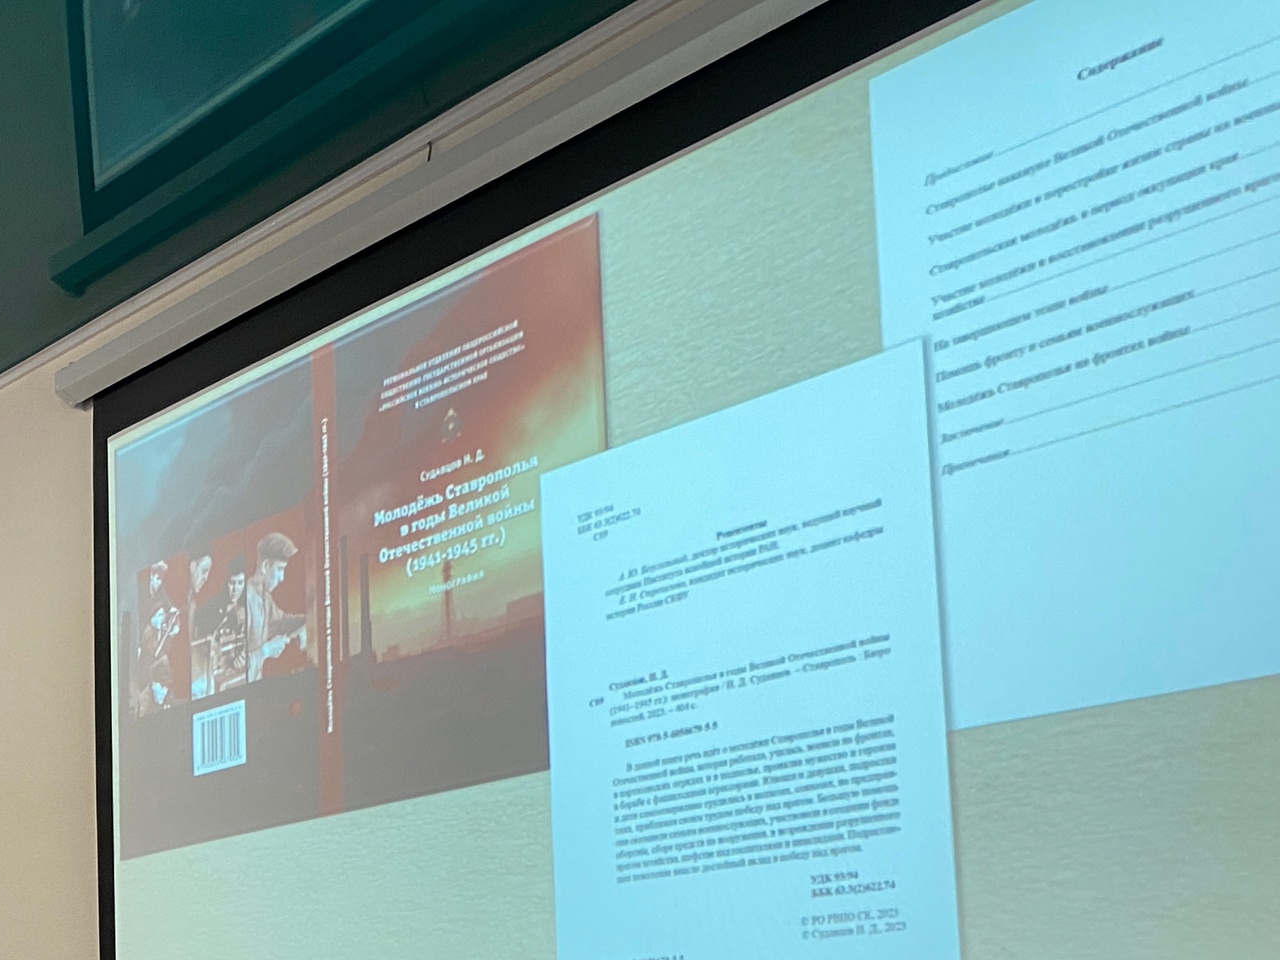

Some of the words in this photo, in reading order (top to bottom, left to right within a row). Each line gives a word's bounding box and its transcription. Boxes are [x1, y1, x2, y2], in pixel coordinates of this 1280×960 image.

[1076, 37, 1164, 80] Содержание
[1053, 134, 1105, 164] Великой
[1106, 94, 1203, 141] Отечественной
[373, 493, 443, 527] Молодёжь
[445, 450, 539, 499] Ставрополья
[400, 524, 409, 536] в
[411, 509, 446, 533] годы
[448, 483, 510, 519] Великой
[378, 513, 484, 563] Отечественной
[486, 497, 534, 525] войны
[405, 536, 478, 577] (1941-1945
[480, 525, 506, 548] гг.)
